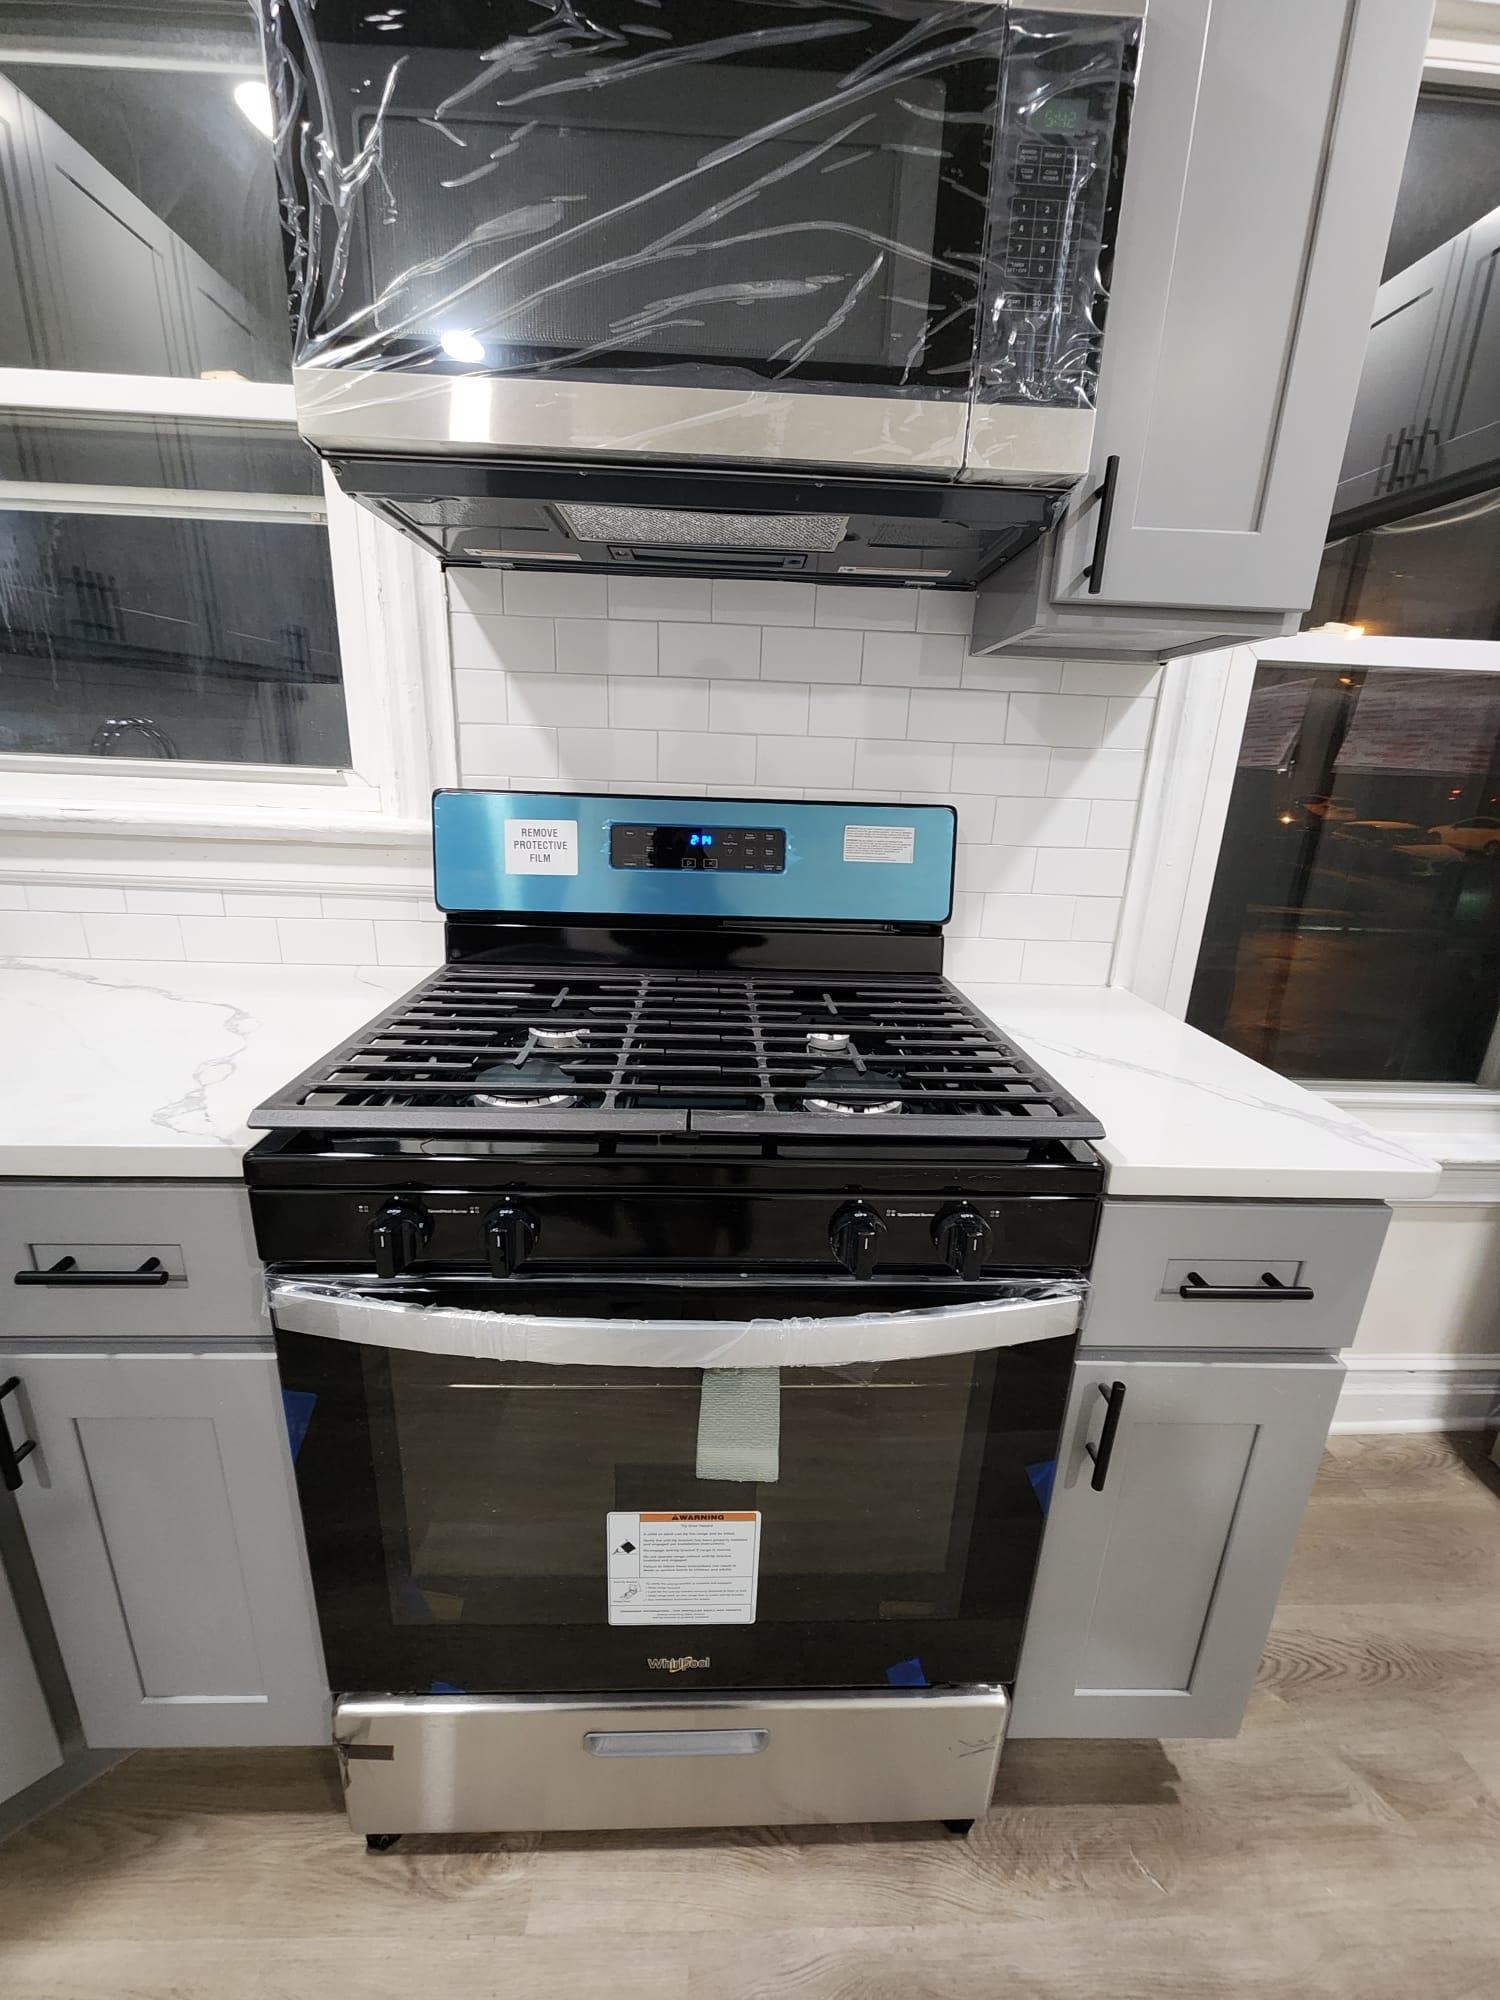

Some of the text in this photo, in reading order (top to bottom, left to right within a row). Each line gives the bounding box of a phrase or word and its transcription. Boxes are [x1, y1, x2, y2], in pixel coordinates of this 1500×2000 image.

[1045, 206, 1050, 214] 2
[1018, 224, 1024, 233] 4
[1017, 244, 1022, 252] 7
[521, 828, 558, 838] REMOVE
[513, 841, 568, 850] PROTECTIVE
[529, 853, 551, 863] FILM
[647, 1656, 710, 1673] Whirlpool
